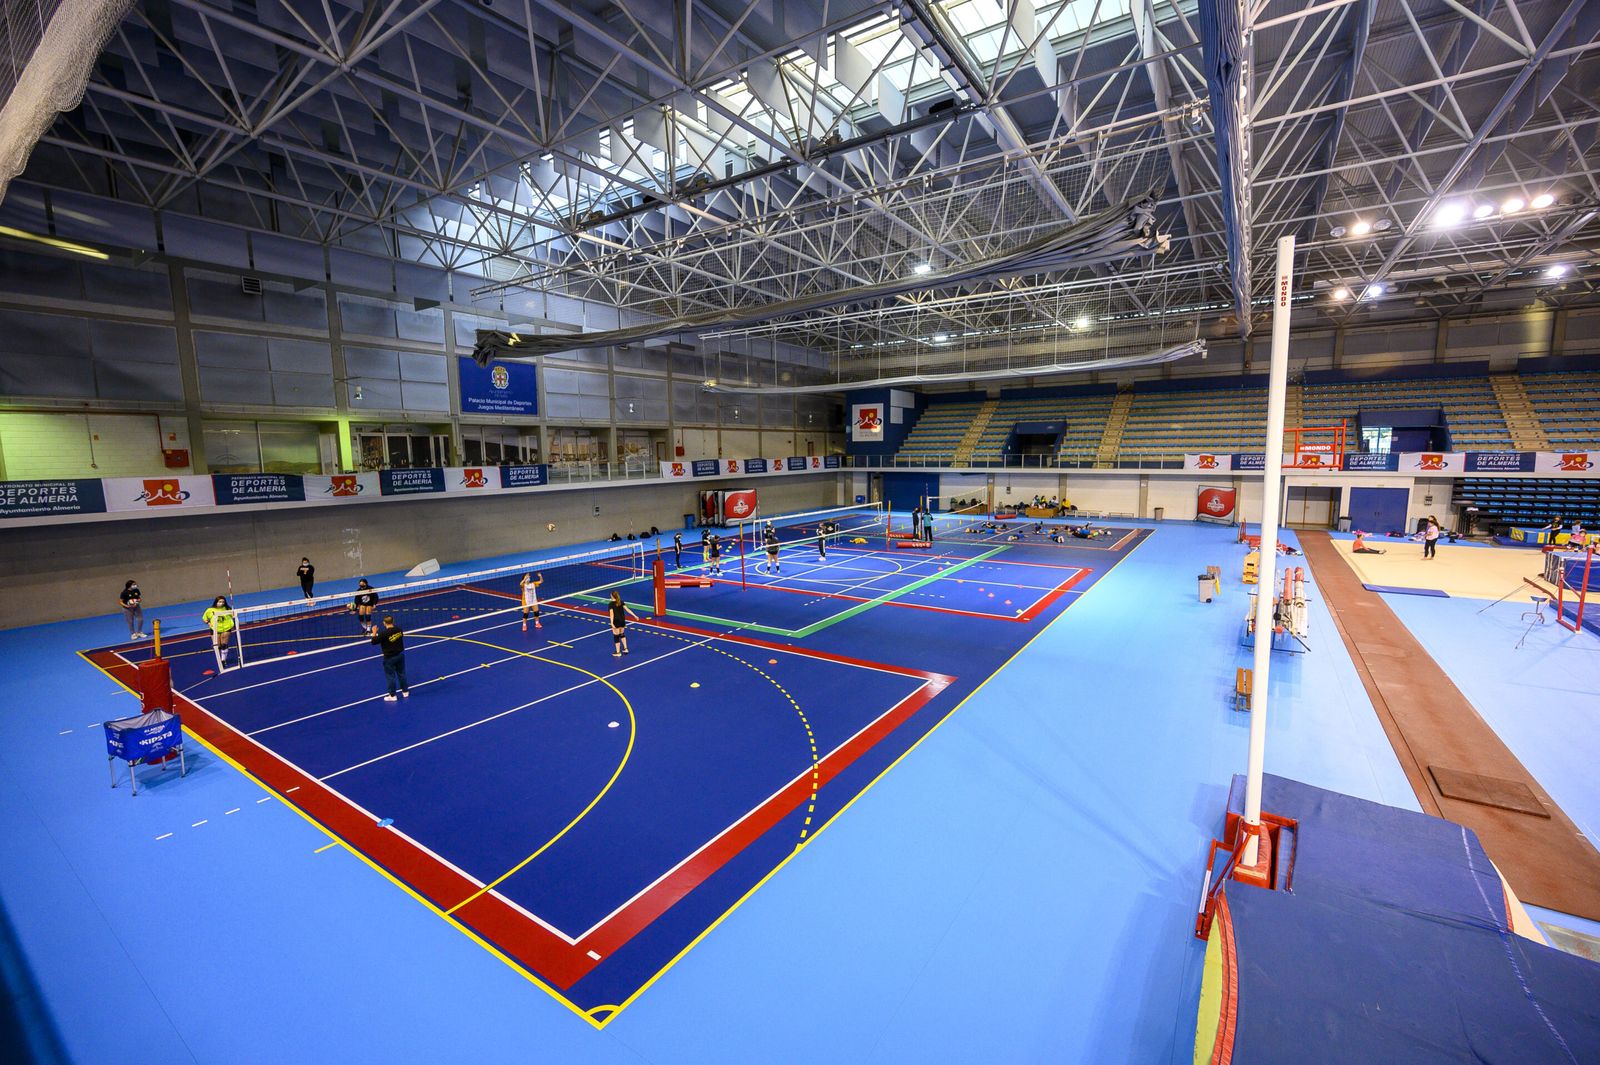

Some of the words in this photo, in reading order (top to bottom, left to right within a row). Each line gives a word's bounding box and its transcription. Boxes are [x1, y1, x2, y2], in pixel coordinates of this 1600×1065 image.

[1280, 280, 1288, 307] MONDO
[231, 479, 286, 487] DEPORTES
[0, 486, 77, 497] DEPORTES
[247, 485, 287, 493] ALMERIA
[20, 494, 78, 504] ALMERIA
[0, 506, 51, 515] Ayuntamiento
